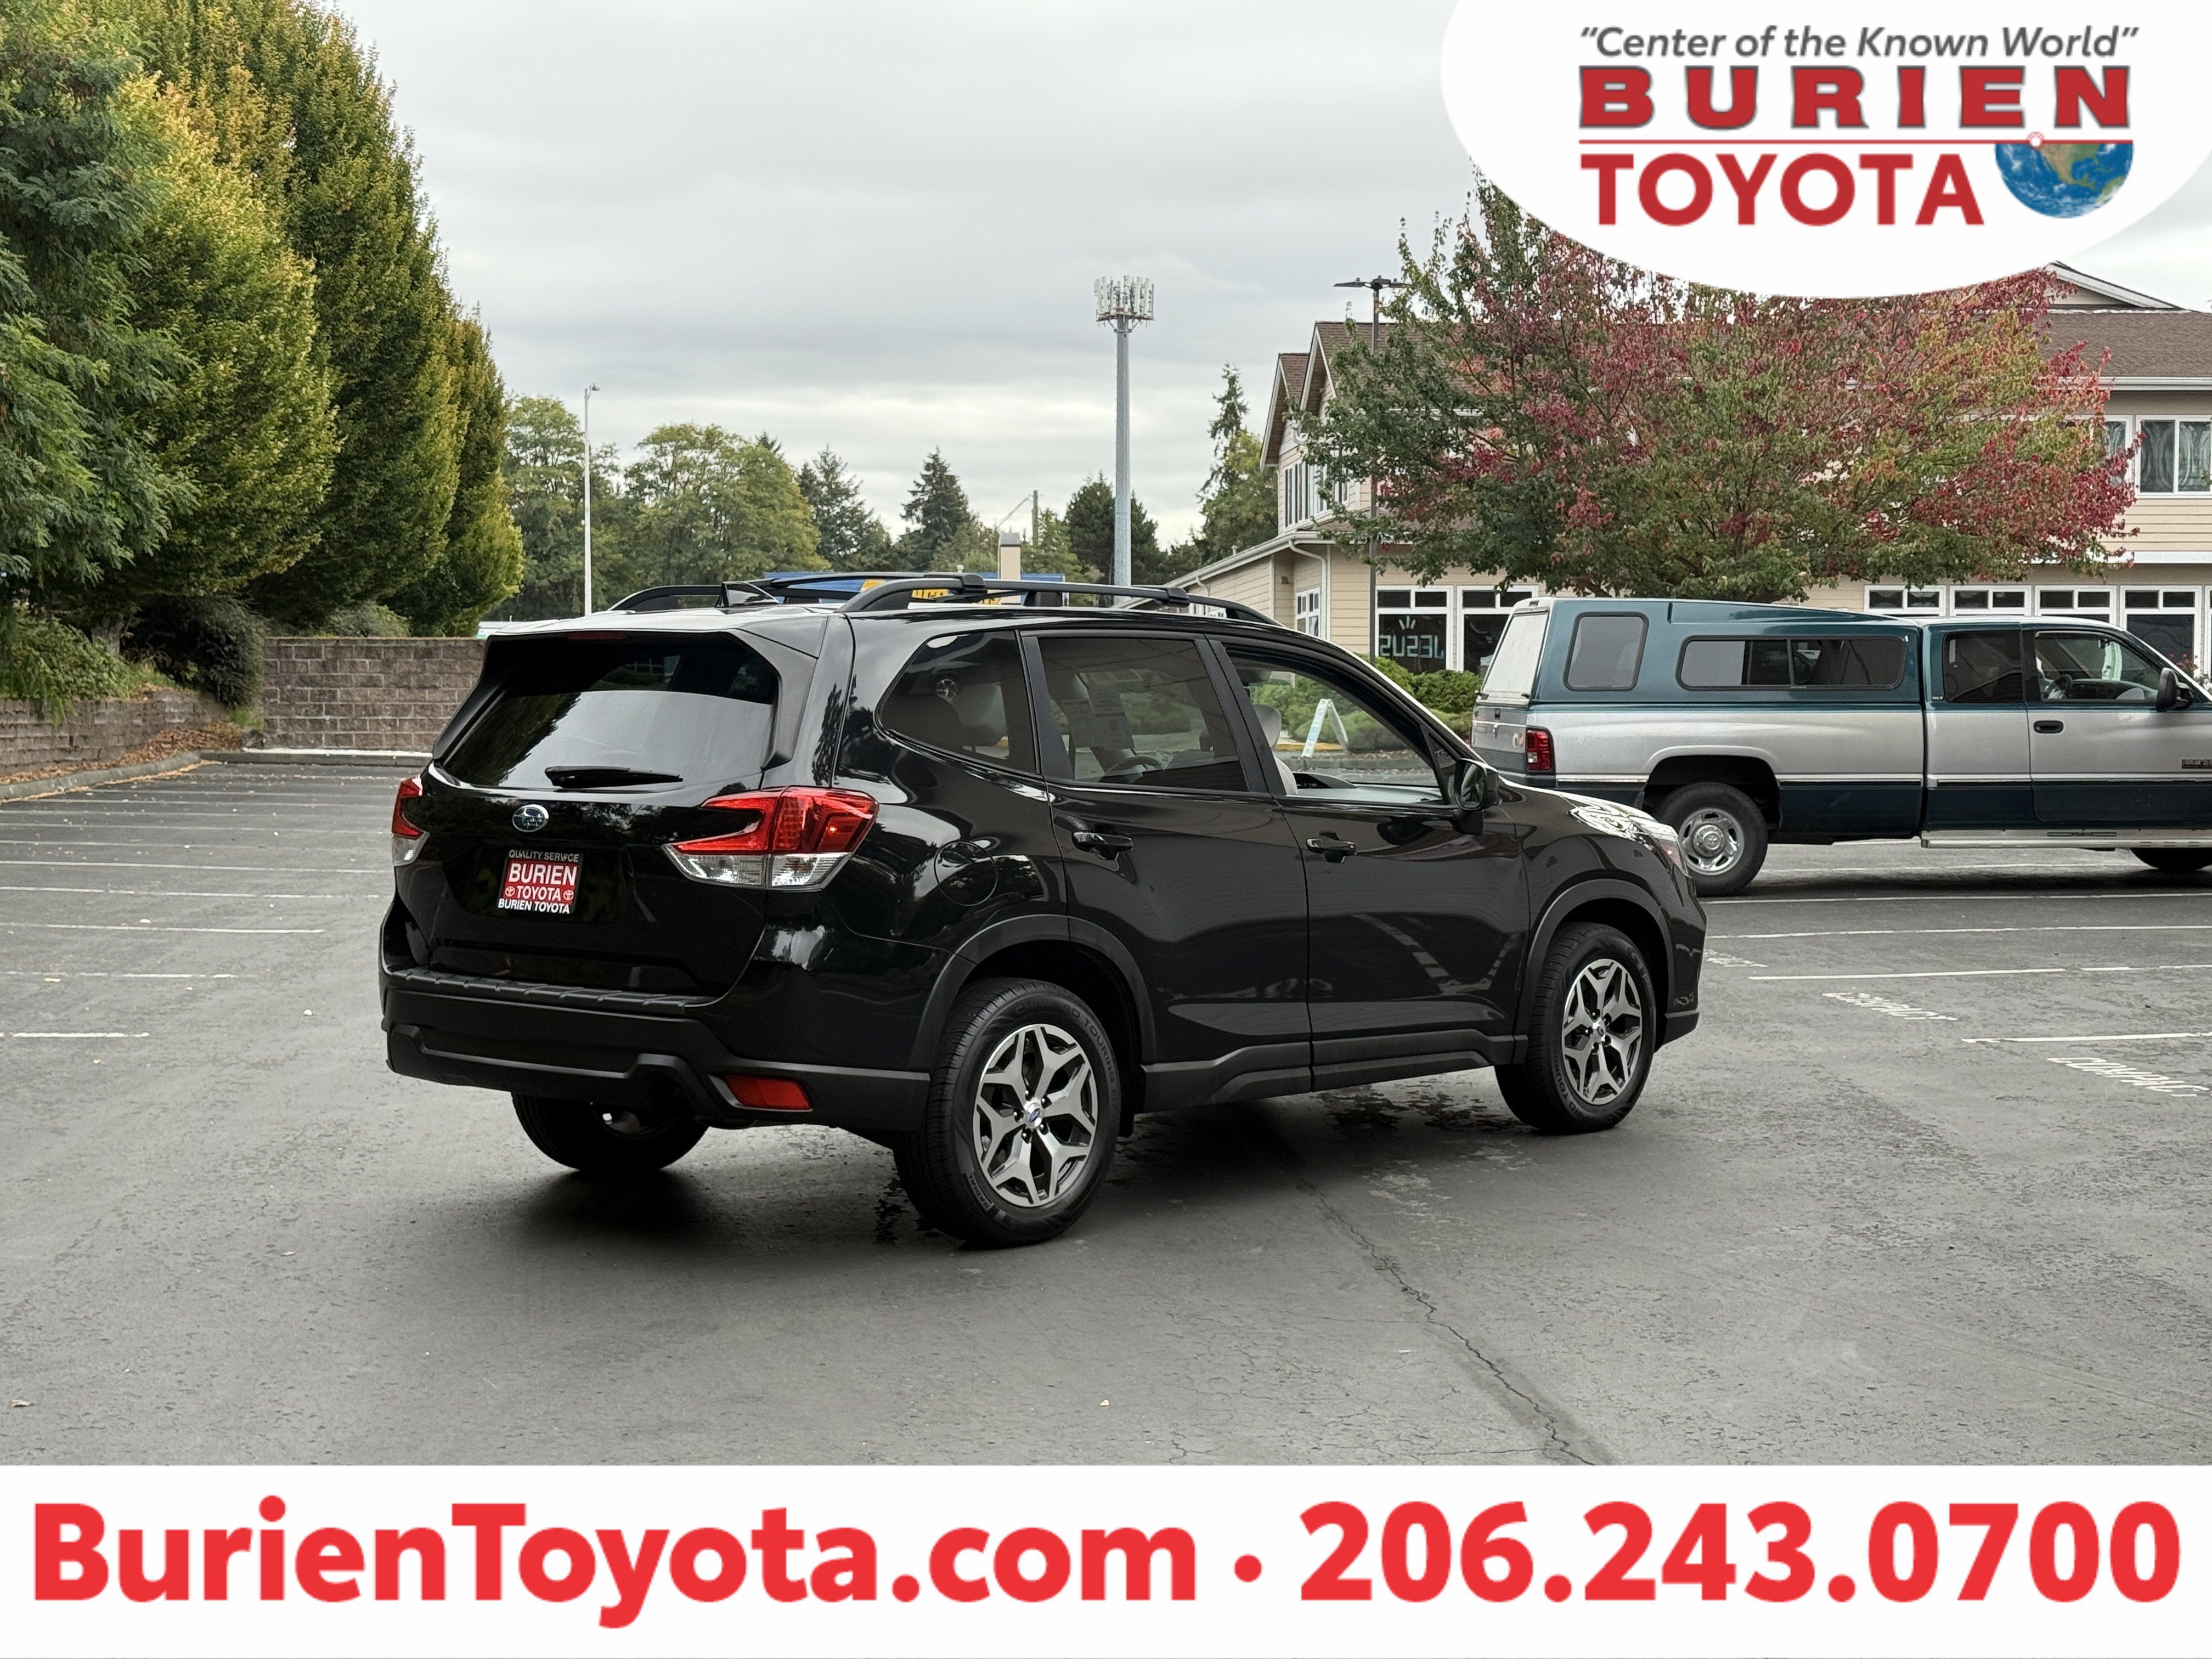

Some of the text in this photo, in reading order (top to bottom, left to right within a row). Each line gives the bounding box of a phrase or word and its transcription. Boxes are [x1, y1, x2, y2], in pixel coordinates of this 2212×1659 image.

[509, 850, 543, 860] QUALITY
[508, 862, 578, 886] BURIEN
[516, 885, 562, 901] TOYOTA
[498, 899, 570, 915] BURIEN TOYOTA
